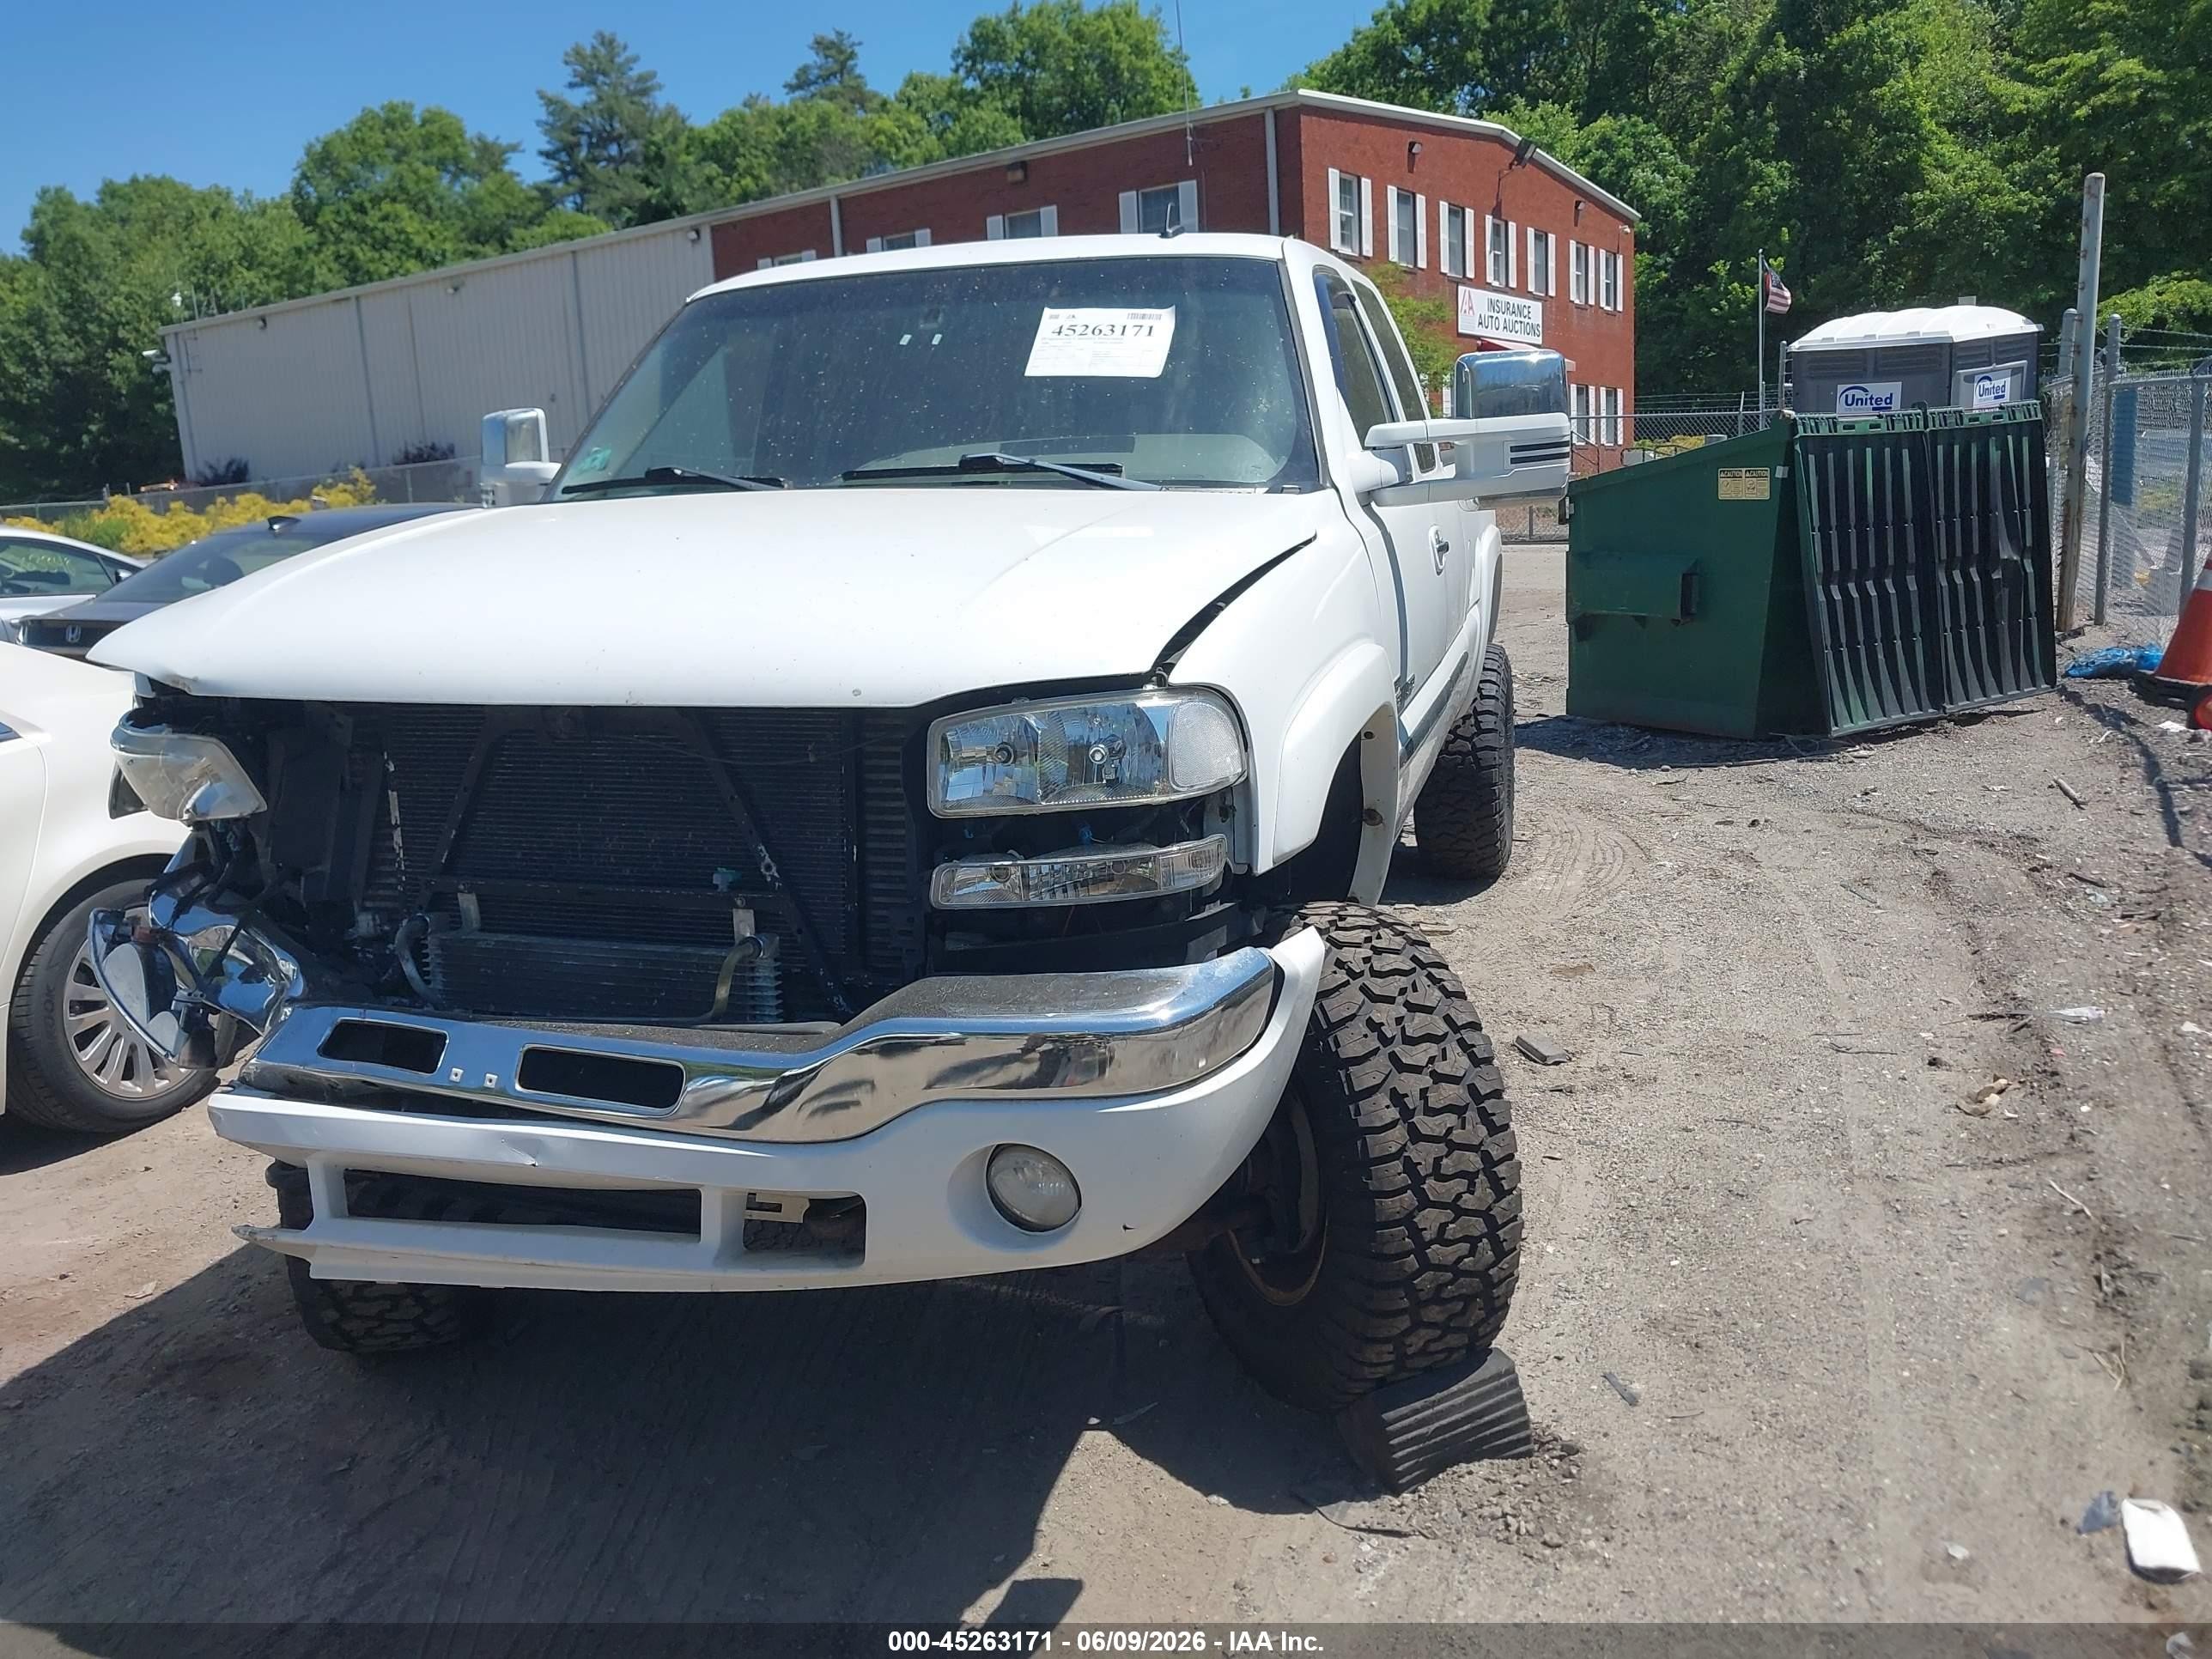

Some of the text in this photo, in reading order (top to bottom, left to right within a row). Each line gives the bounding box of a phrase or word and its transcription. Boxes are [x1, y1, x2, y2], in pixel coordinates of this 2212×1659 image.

[1487, 298, 1531, 319] INSURANCE
[1051, 324, 1154, 337] 45263171
[1478, 313, 1540, 337] AUTO AUCTIONS
[1978, 380, 2007, 398] United
[1844, 392, 1893, 406] United
